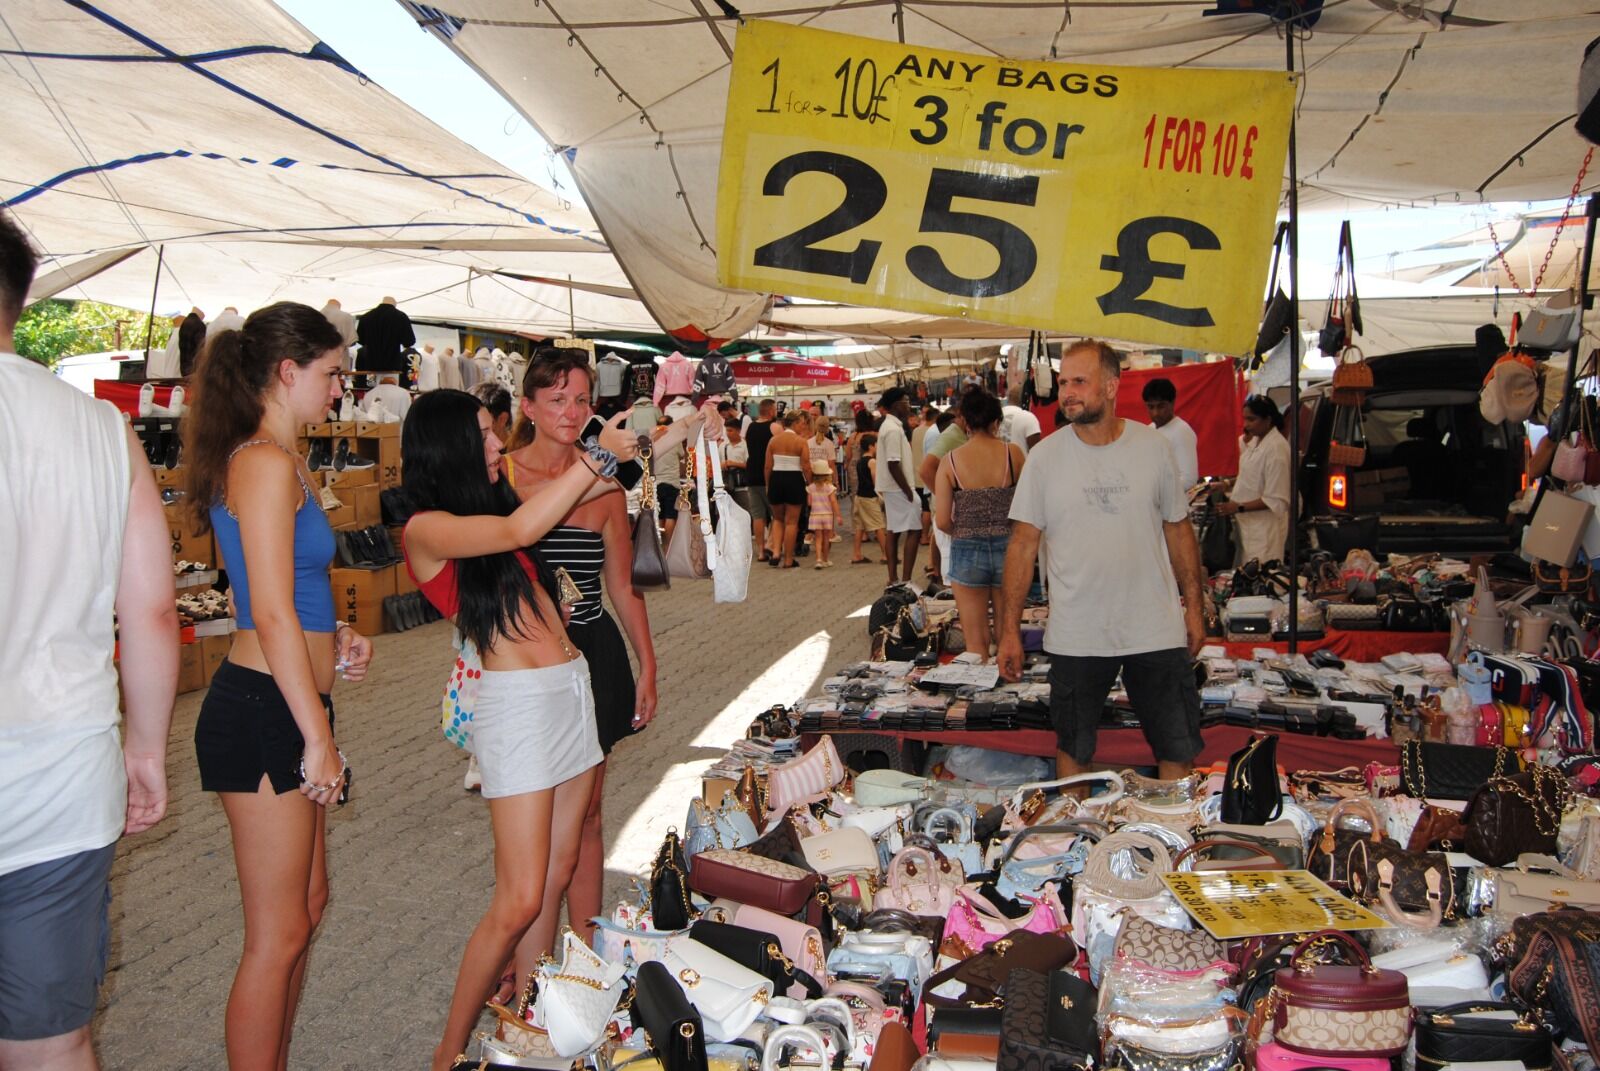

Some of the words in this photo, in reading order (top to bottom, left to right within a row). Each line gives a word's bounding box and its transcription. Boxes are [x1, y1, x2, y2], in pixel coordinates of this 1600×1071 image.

[757, 57, 780, 113] 1
[894, 54, 985, 83] ANY
[997, 67, 1119, 98] BAGS
[910, 95, 949, 145] 3
[976, 101, 1086, 160] for
[1143, 114, 1157, 168] 1
[1158, 117, 1206, 174] FOR
[1213, 123, 1238, 178] 10
[1240, 125, 1259, 180] £
[753, 150, 1038, 298] 25
[1095, 216, 1222, 328] £
[806, 368, 829, 376] ALGIDA
[346, 583, 357, 623] B.K.S.
[1171, 880, 1196, 896] FOR
[1184, 896, 1205, 906] 30
[1193, 907, 1217, 921] Euro
